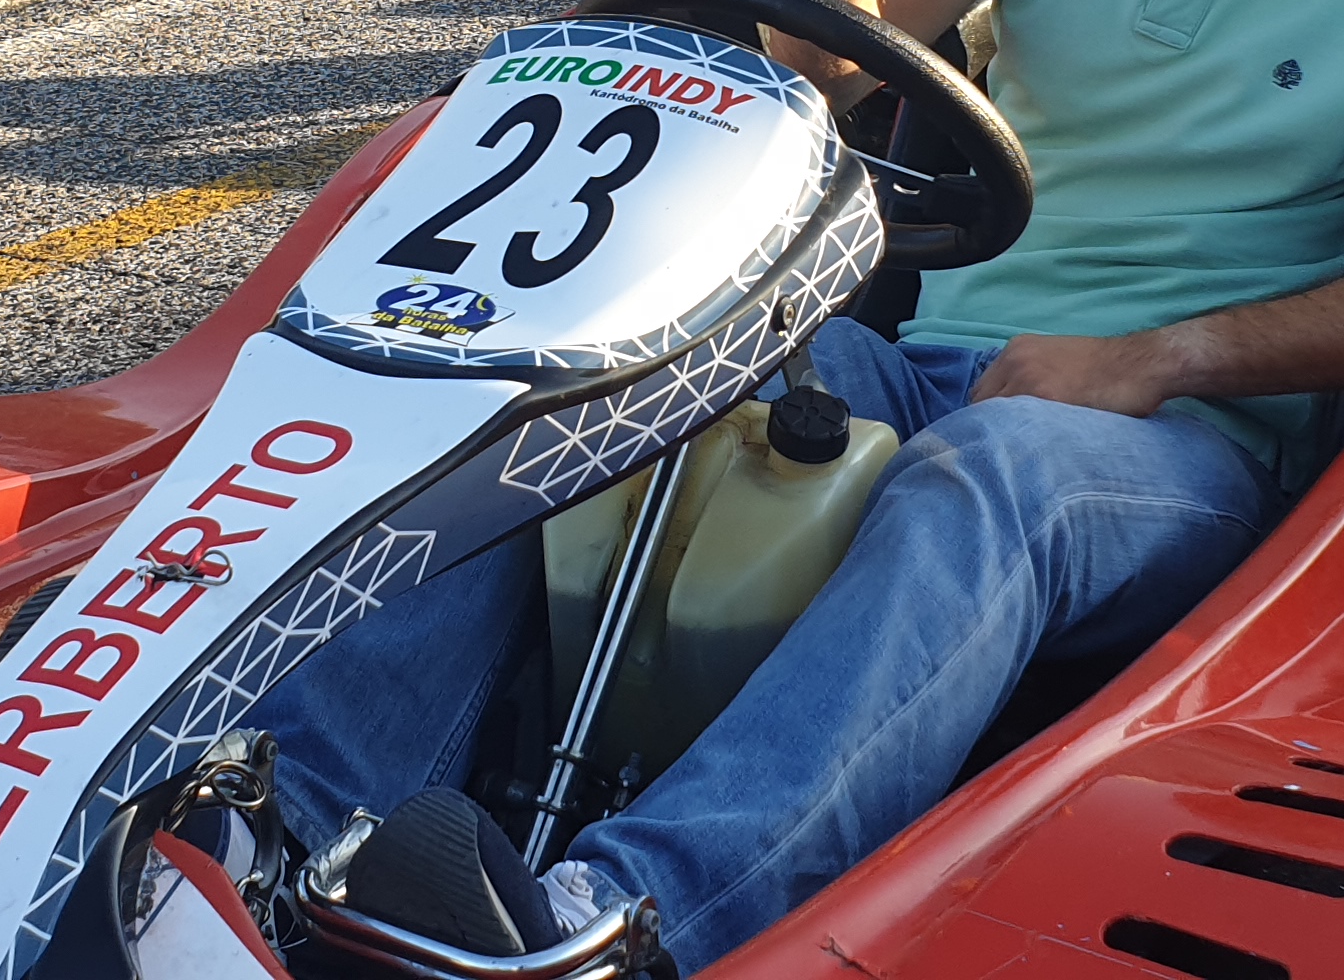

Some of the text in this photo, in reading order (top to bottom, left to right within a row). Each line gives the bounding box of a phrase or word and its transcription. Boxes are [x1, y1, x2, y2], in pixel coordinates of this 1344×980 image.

[486, 54, 758, 116] EUROINDY
[589, 88, 741, 135] Kartódromo da Batalha
[375, 93, 662, 289] 23
[387, 283, 479, 321] 24
[402, 306, 449, 321] horas
[371, 311, 470, 336] da Batalha
